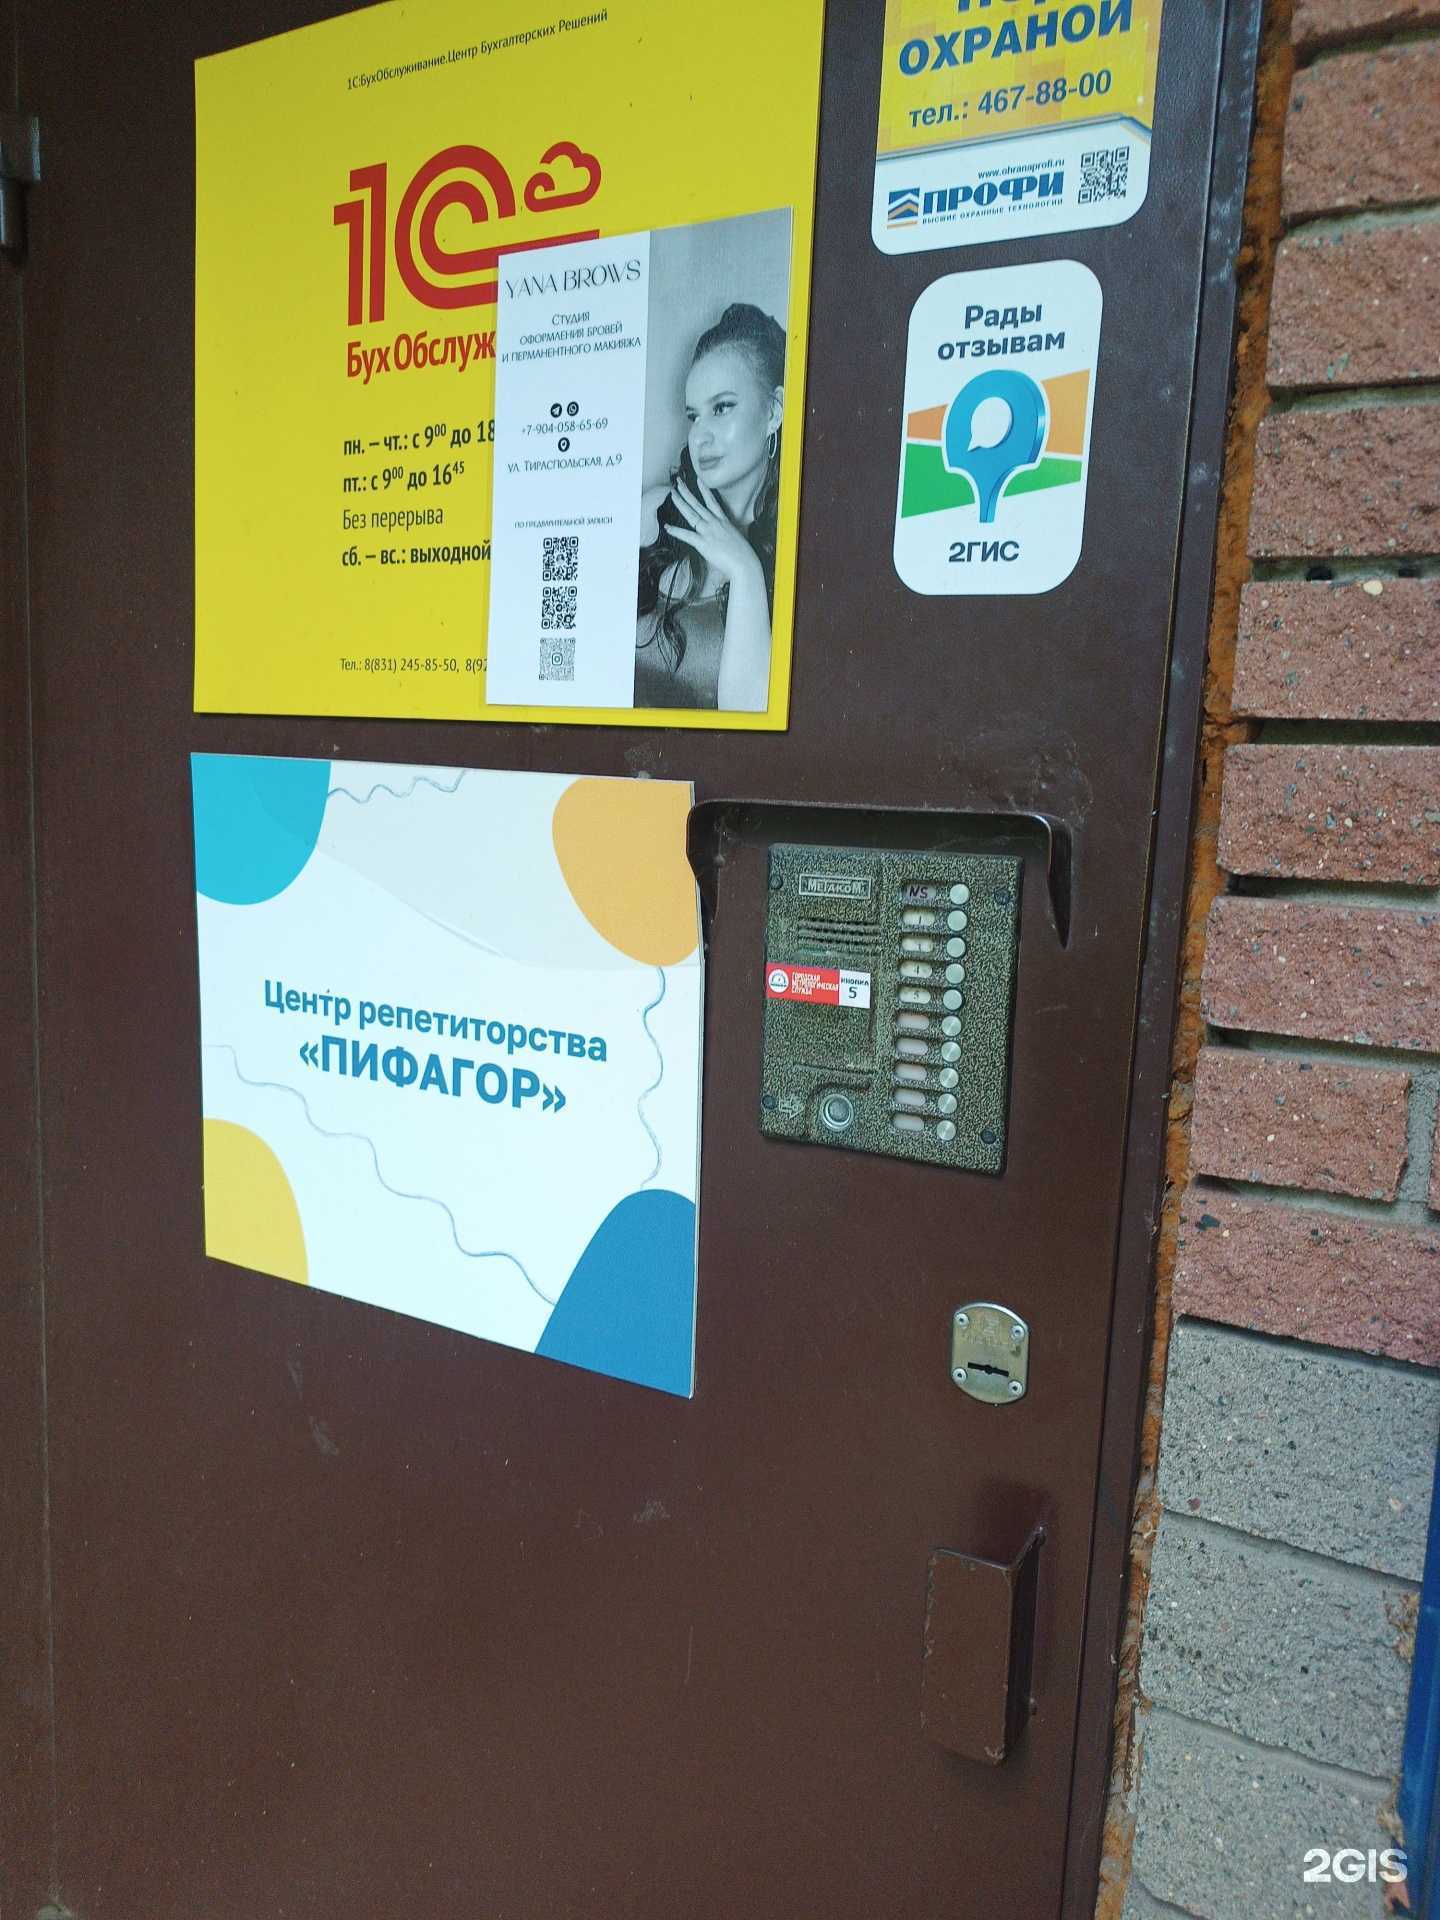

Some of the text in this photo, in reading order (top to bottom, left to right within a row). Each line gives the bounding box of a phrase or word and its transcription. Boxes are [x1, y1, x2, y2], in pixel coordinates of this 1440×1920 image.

[480, 24, 557, 55] Бухгалтерских
[558, 8, 609, 33] Решений
[909, 69, 1112, 128] тел.: 467-88-00
[922, 171, 1065, 216] ПРОФИ
[1008, 198, 1063, 213] ТЕХНОЛОГИИ
[505, 259, 641, 300] YANA BROWS
[551, 311, 590, 326] СТУДИЯ
[964, 304, 1043, 330] Рады
[519, 321, 623, 346] ОФОРМЛЕНИЯ БРОВЕЙ
[937, 331, 1066, 361] отзывам
[501, 336, 641, 363] И ПЕРМАНЕНТНОГО МАКИЯЖА
[343, 439, 365, 456] пн.
[384, 434, 408, 451] чт.:
[412, 432, 420, 448] с
[450, 427, 471, 448] до
[343, 475, 367, 493] пт.:
[371, 475, 378, 490] с
[407, 470, 427, 491] до
[343, 507, 443, 532] Без перерыва
[342, 546, 361, 566] сб.
[380, 549, 406, 565] вс.:
[410, 539, 491, 565] выходной
[948, 541, 1020, 562] 2ГИС
[340, 658, 362, 671] Тел.:
[364, 658, 397, 674] 8(831)
[400, 658, 459, 673] 245-85-50,
[848, 986, 857, 998] 5
[264, 979, 607, 1062] Центр репетиторства
[299, 1034, 566, 1113] «ПИФАГОР»
